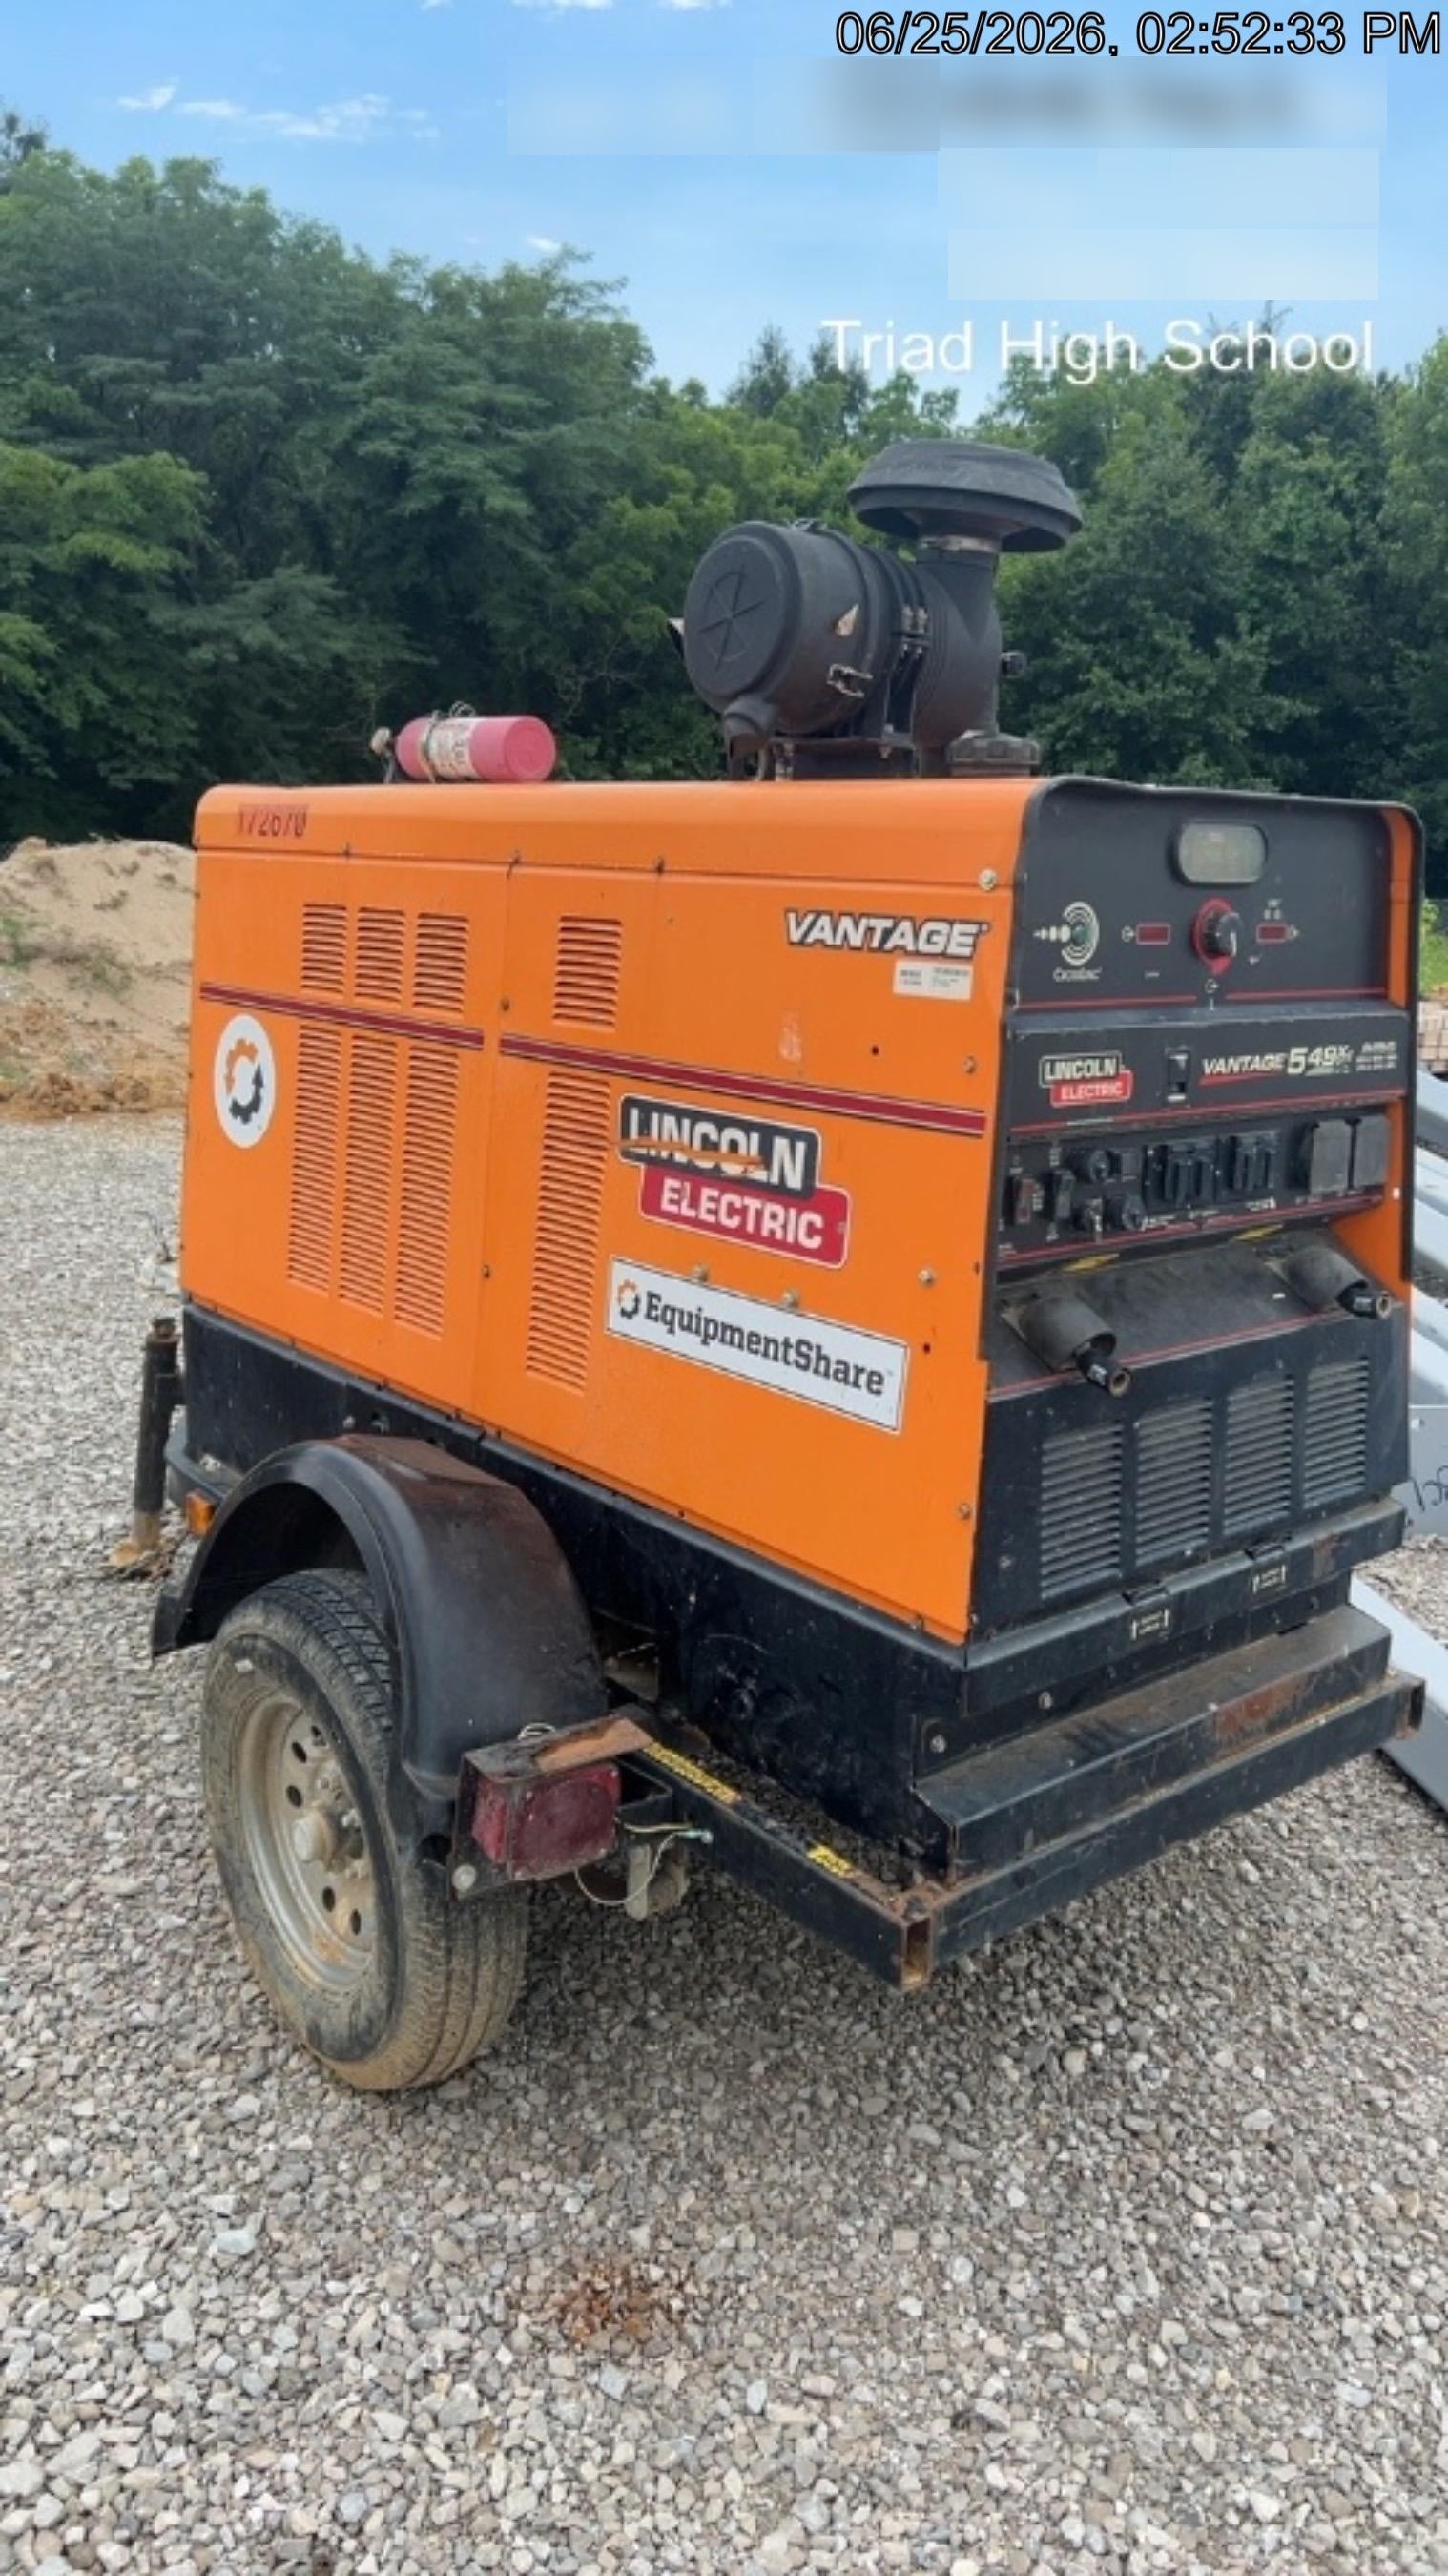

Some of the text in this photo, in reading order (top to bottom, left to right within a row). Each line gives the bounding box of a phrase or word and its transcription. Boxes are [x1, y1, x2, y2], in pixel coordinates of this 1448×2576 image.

[784, 909, 981, 957] VANTAGE
[1044, 1057, 1117, 1081] LINCOLN
[1201, 1053, 1288, 1075] VANTAGE
[1060, 1081, 1123, 1101] ELECTRIC
[628, 1106, 807, 1191] LINCOLN
[660, 1176, 824, 1250] ELECTRIC
[644, 1290, 886, 1396] EquipmentShare
